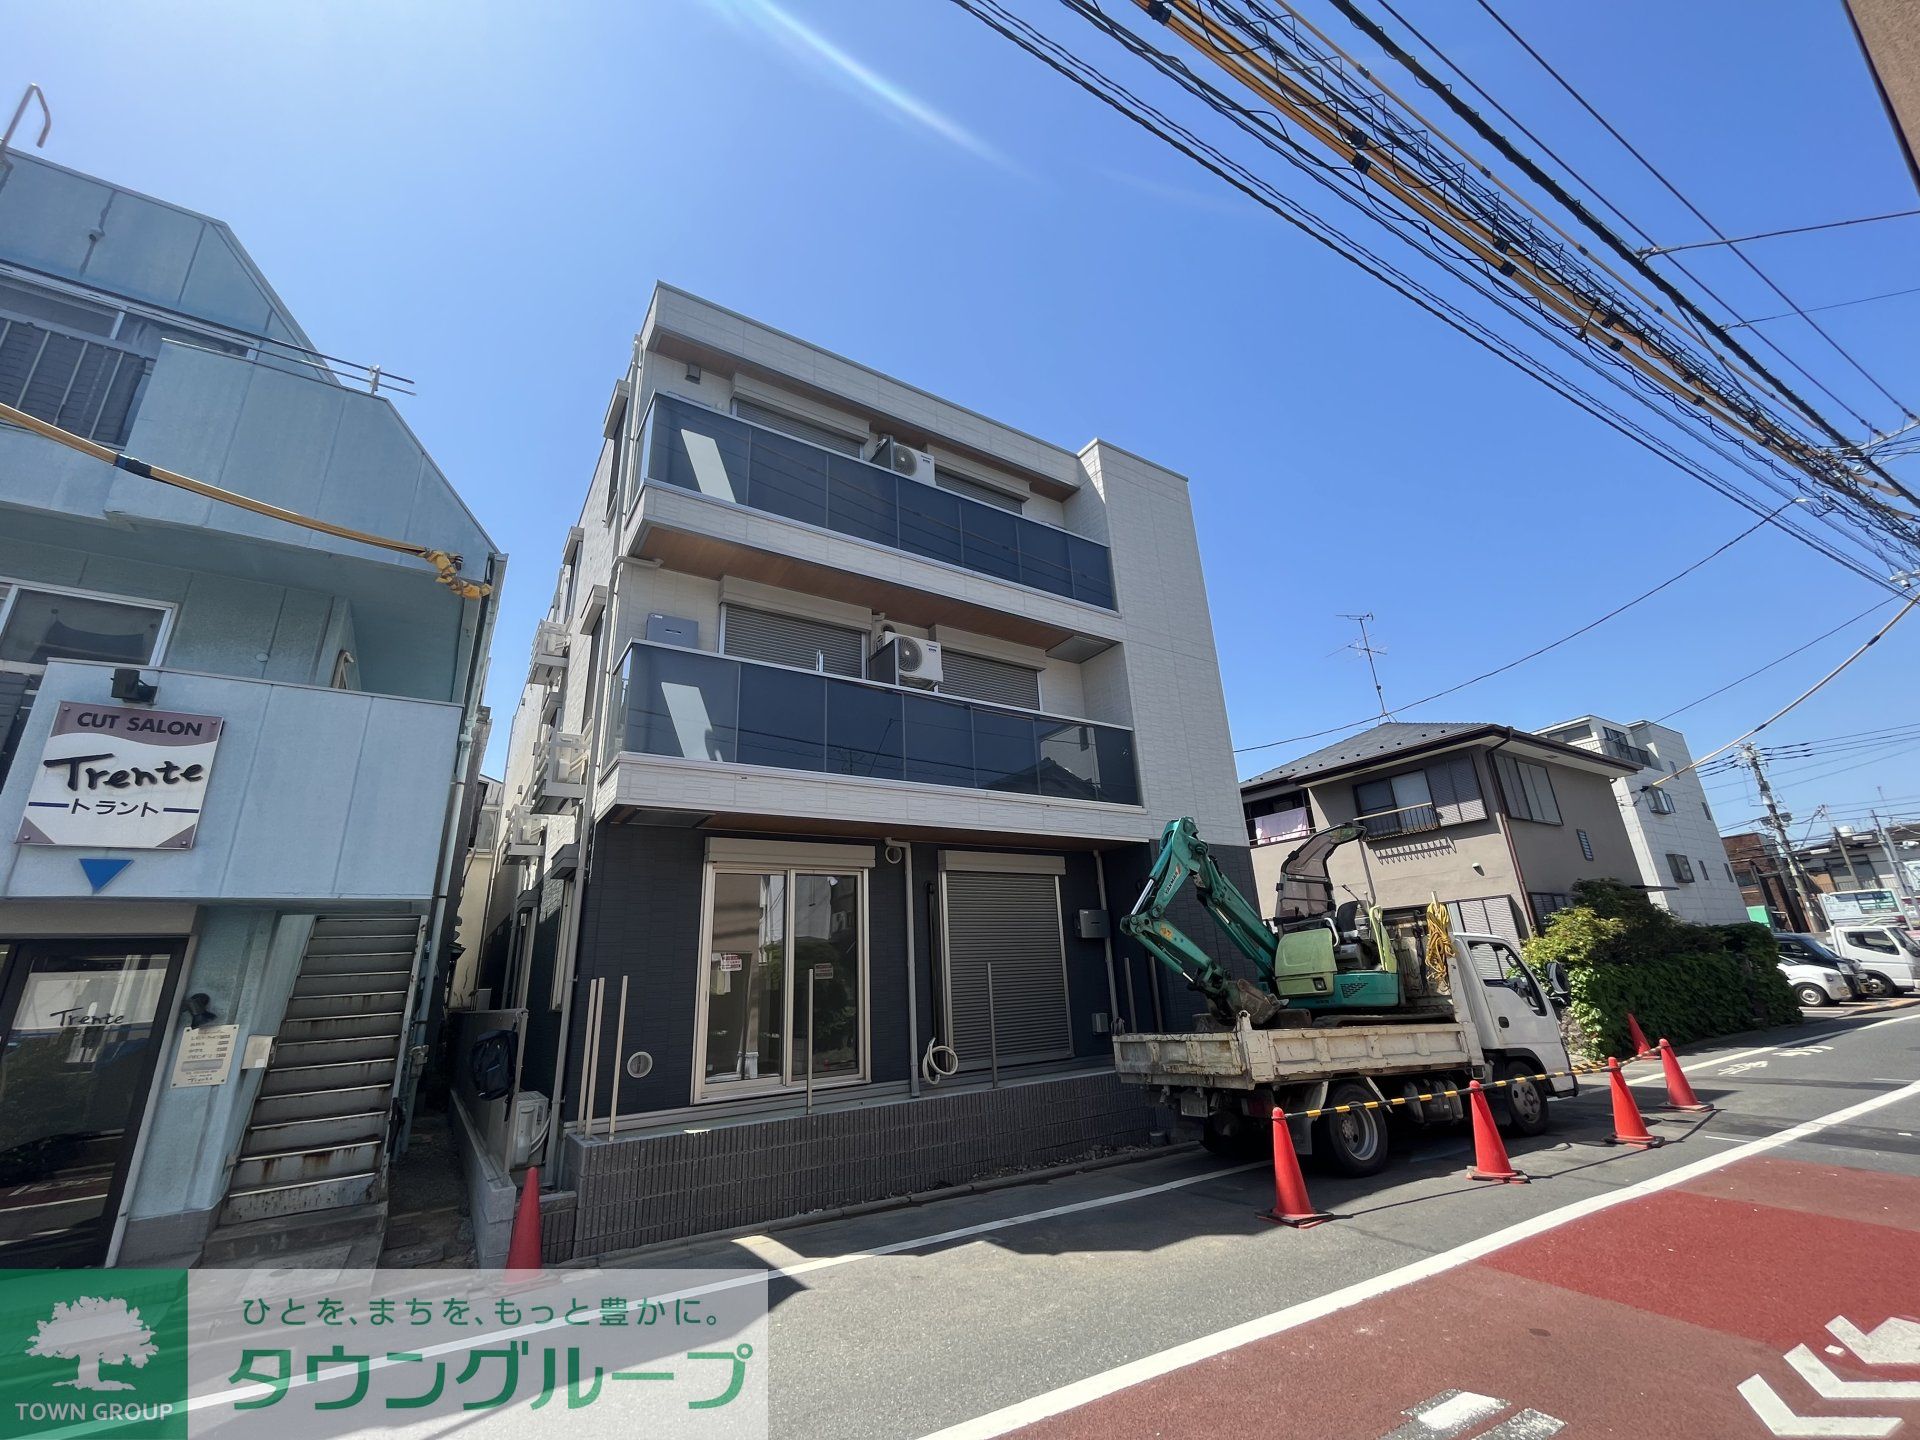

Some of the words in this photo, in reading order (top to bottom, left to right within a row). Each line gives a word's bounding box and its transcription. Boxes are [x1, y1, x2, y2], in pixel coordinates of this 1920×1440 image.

[77, 712, 120, 729] CUT
[126, 717, 203, 736] SALON
[43, 753, 204, 791] Trente
[71, 798, 159, 817] トラント
[50, 1007, 124, 1026] Trente
